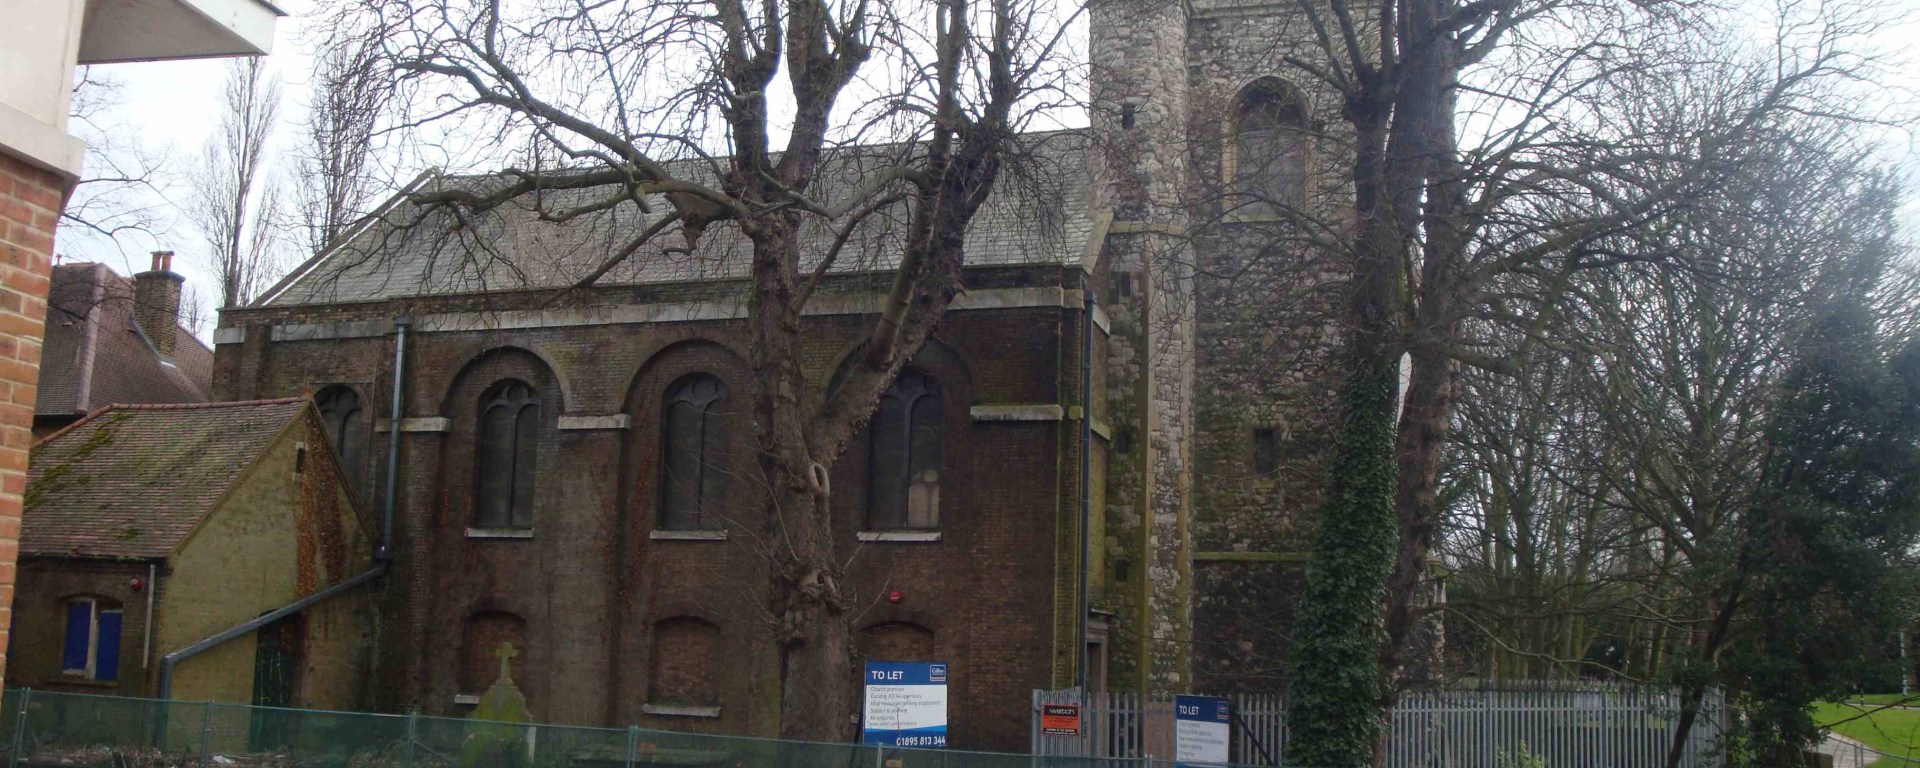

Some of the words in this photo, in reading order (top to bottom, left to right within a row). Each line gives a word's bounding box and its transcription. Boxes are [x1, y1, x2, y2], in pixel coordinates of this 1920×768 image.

[872, 671, 885, 680] TO
[887, 671, 904, 680] LET
[1179, 705, 1187, 715] TO
[1188, 706, 1200, 715] LET
[896, 736, 918, 746] 01895
[920, 736, 932, 745] 813
[934, 736, 946, 745] 344
